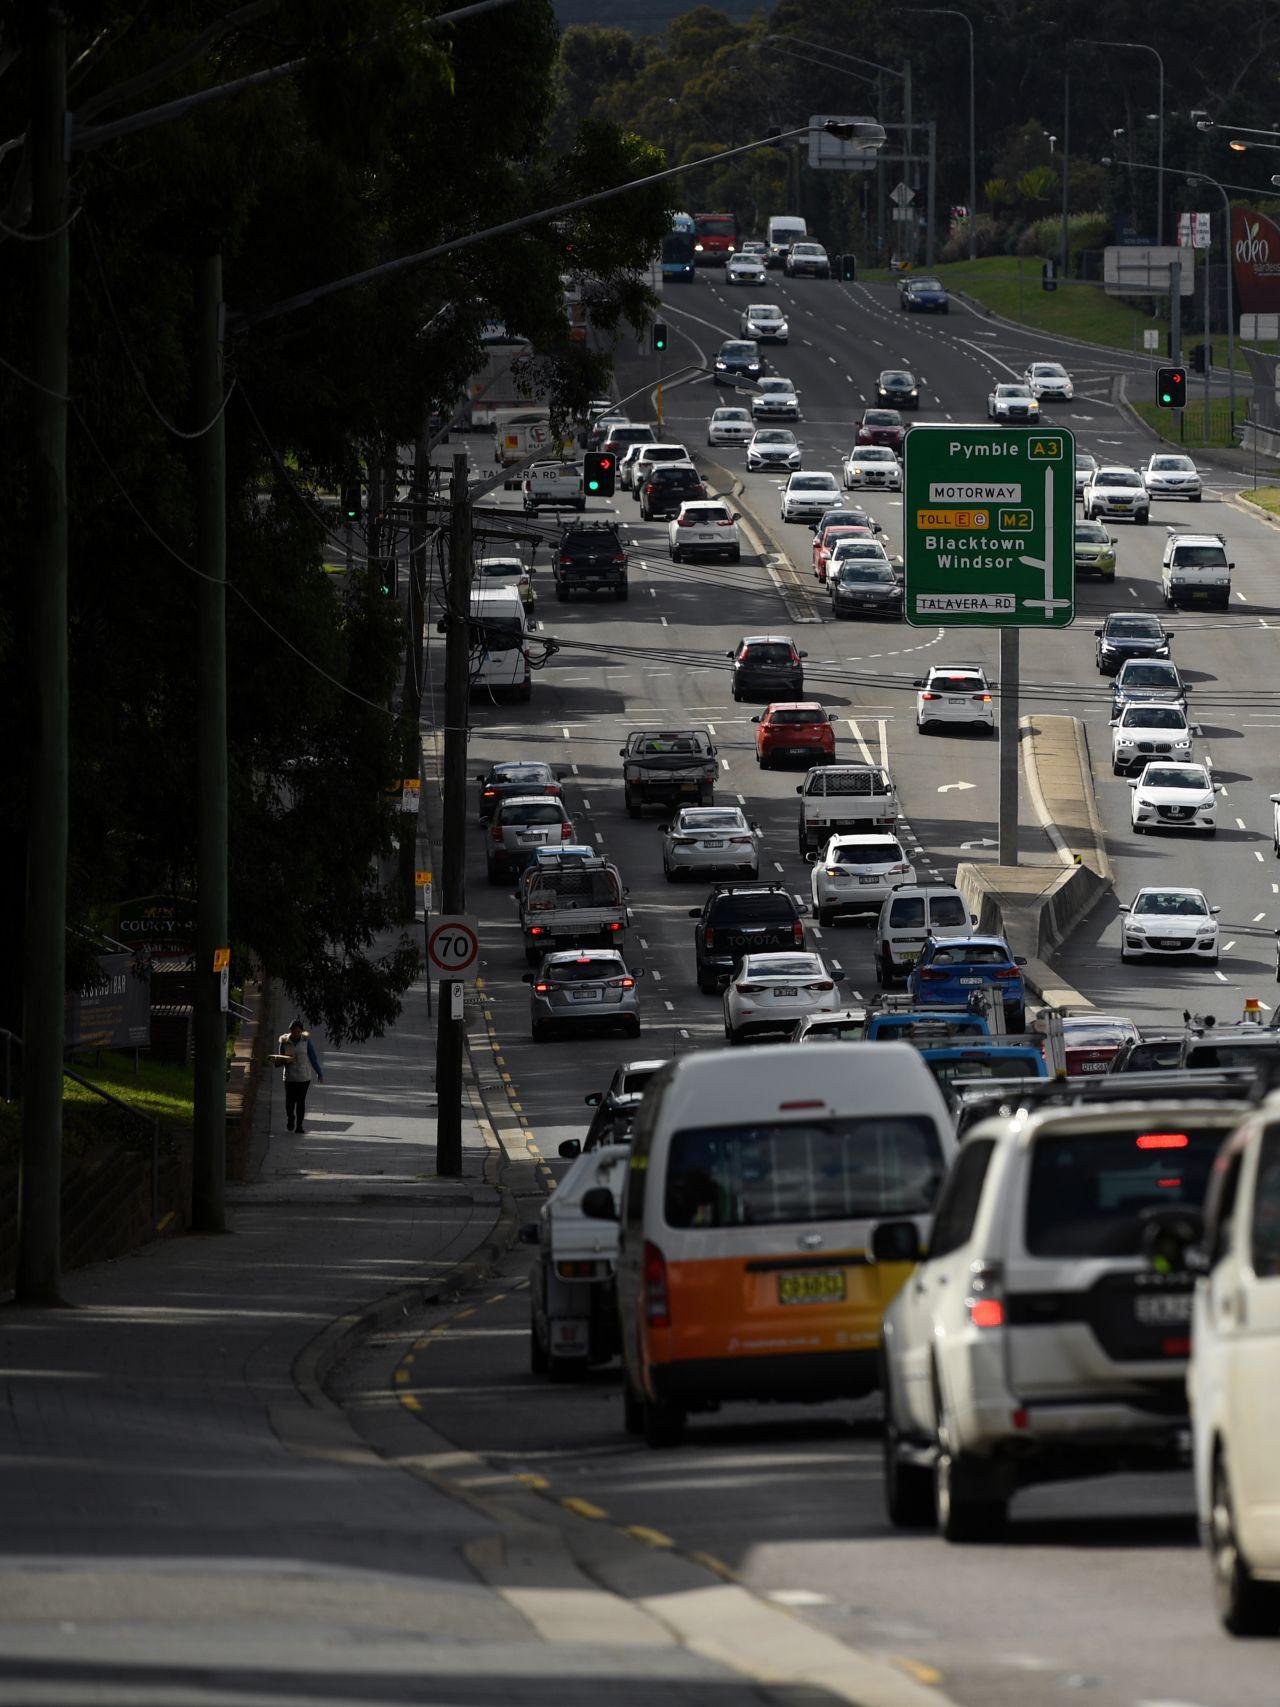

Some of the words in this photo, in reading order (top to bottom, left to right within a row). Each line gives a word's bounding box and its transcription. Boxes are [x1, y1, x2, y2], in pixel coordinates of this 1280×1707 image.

[1236, 216, 1269, 263] eden
[949, 442, 1019, 458] Pymble
[1033, 442, 1058, 455] A3
[482, 471, 537, 479] TAERA
[543, 471, 557, 479] RD
[934, 487, 1016, 498] MOTORWAY
[919, 514, 951, 524] TOLL
[1003, 514, 1029, 527] M2
[925, 536, 1025, 550] Blacktown
[937, 554, 1013, 568] Windsor
[921, 598, 988, 609] TALAVERA
[995, 598, 1011, 609] RD
[438, 937, 469, 957] 70
[728, 936, 781, 946] TOYOTA
[113, 975, 127, 994] BAR
